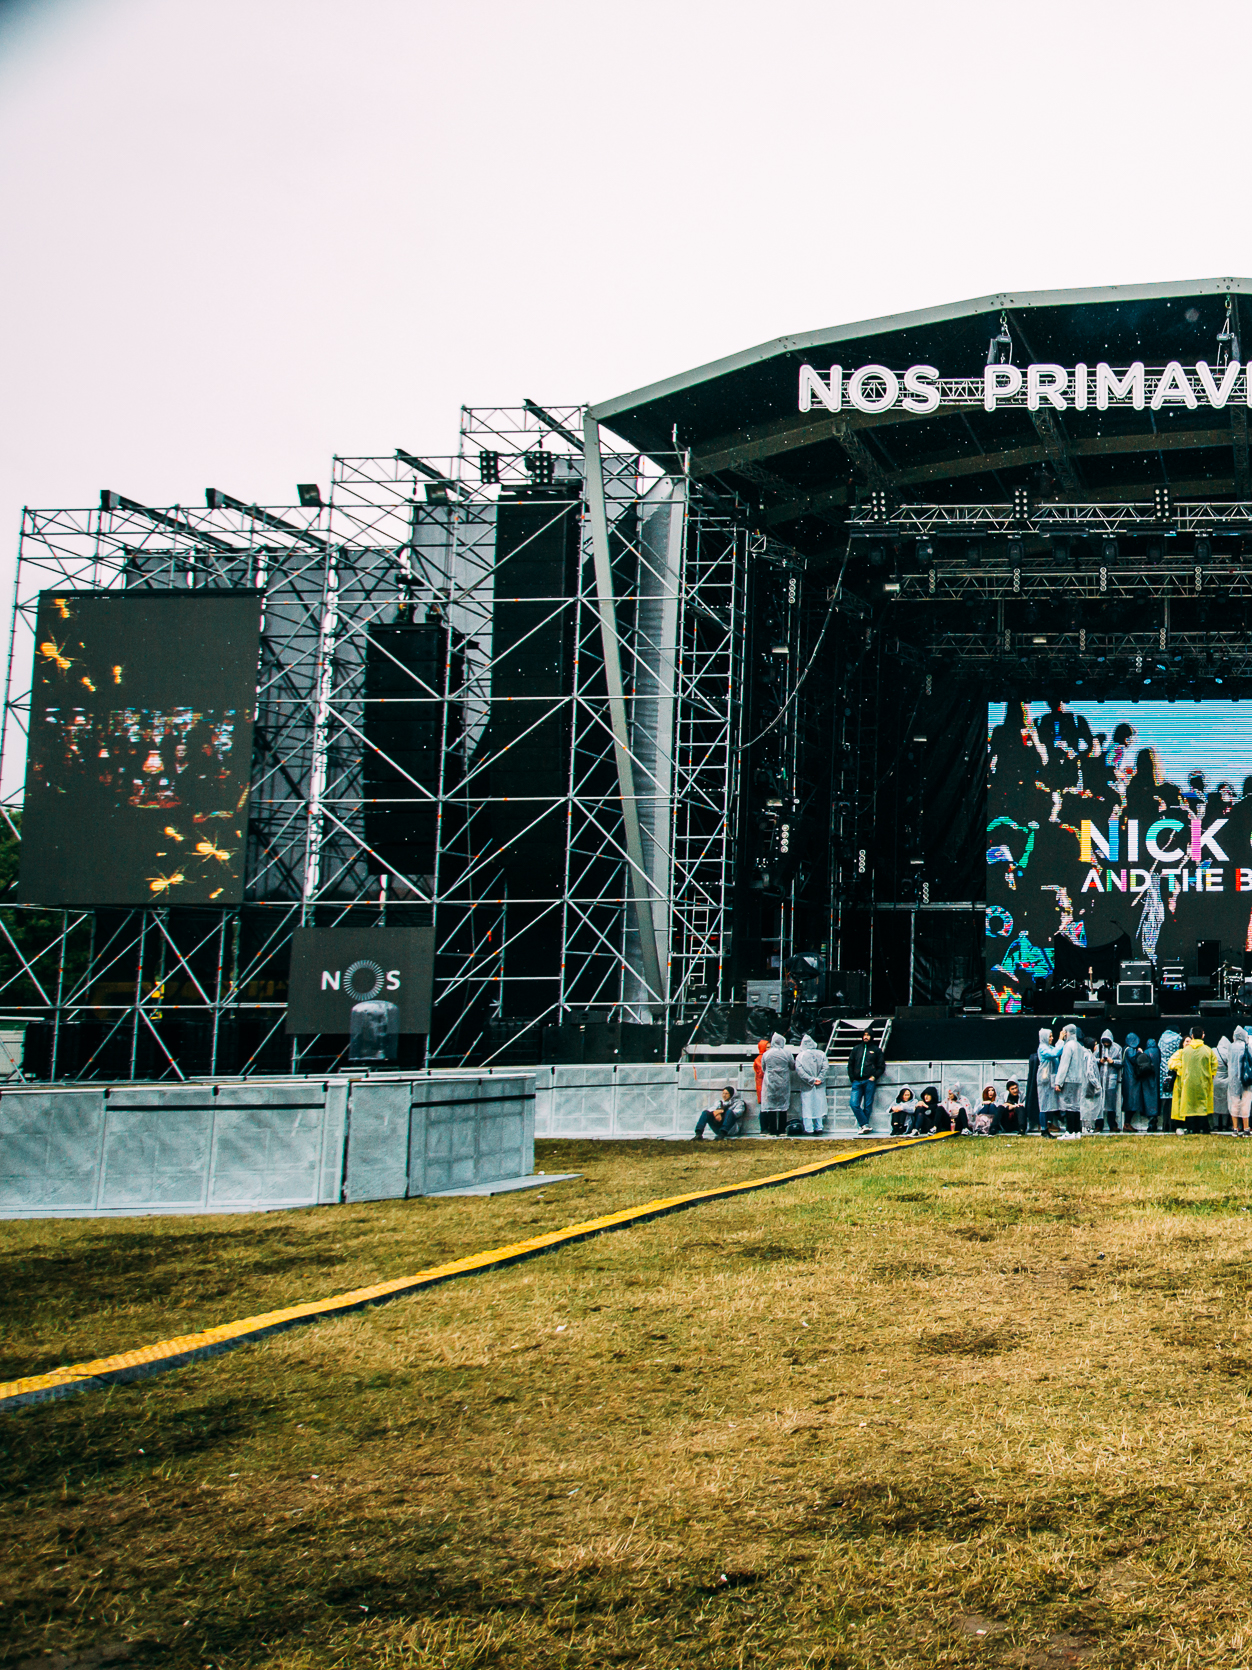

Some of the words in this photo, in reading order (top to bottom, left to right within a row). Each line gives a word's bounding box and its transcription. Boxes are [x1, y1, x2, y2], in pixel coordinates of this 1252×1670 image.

[799, 364, 940, 414] NOS
[1081, 819, 1230, 862] NICK
[1081, 869, 1151, 892] AND
[1160, 868, 1224, 892] THE
[321, 960, 401, 1001] NOS
